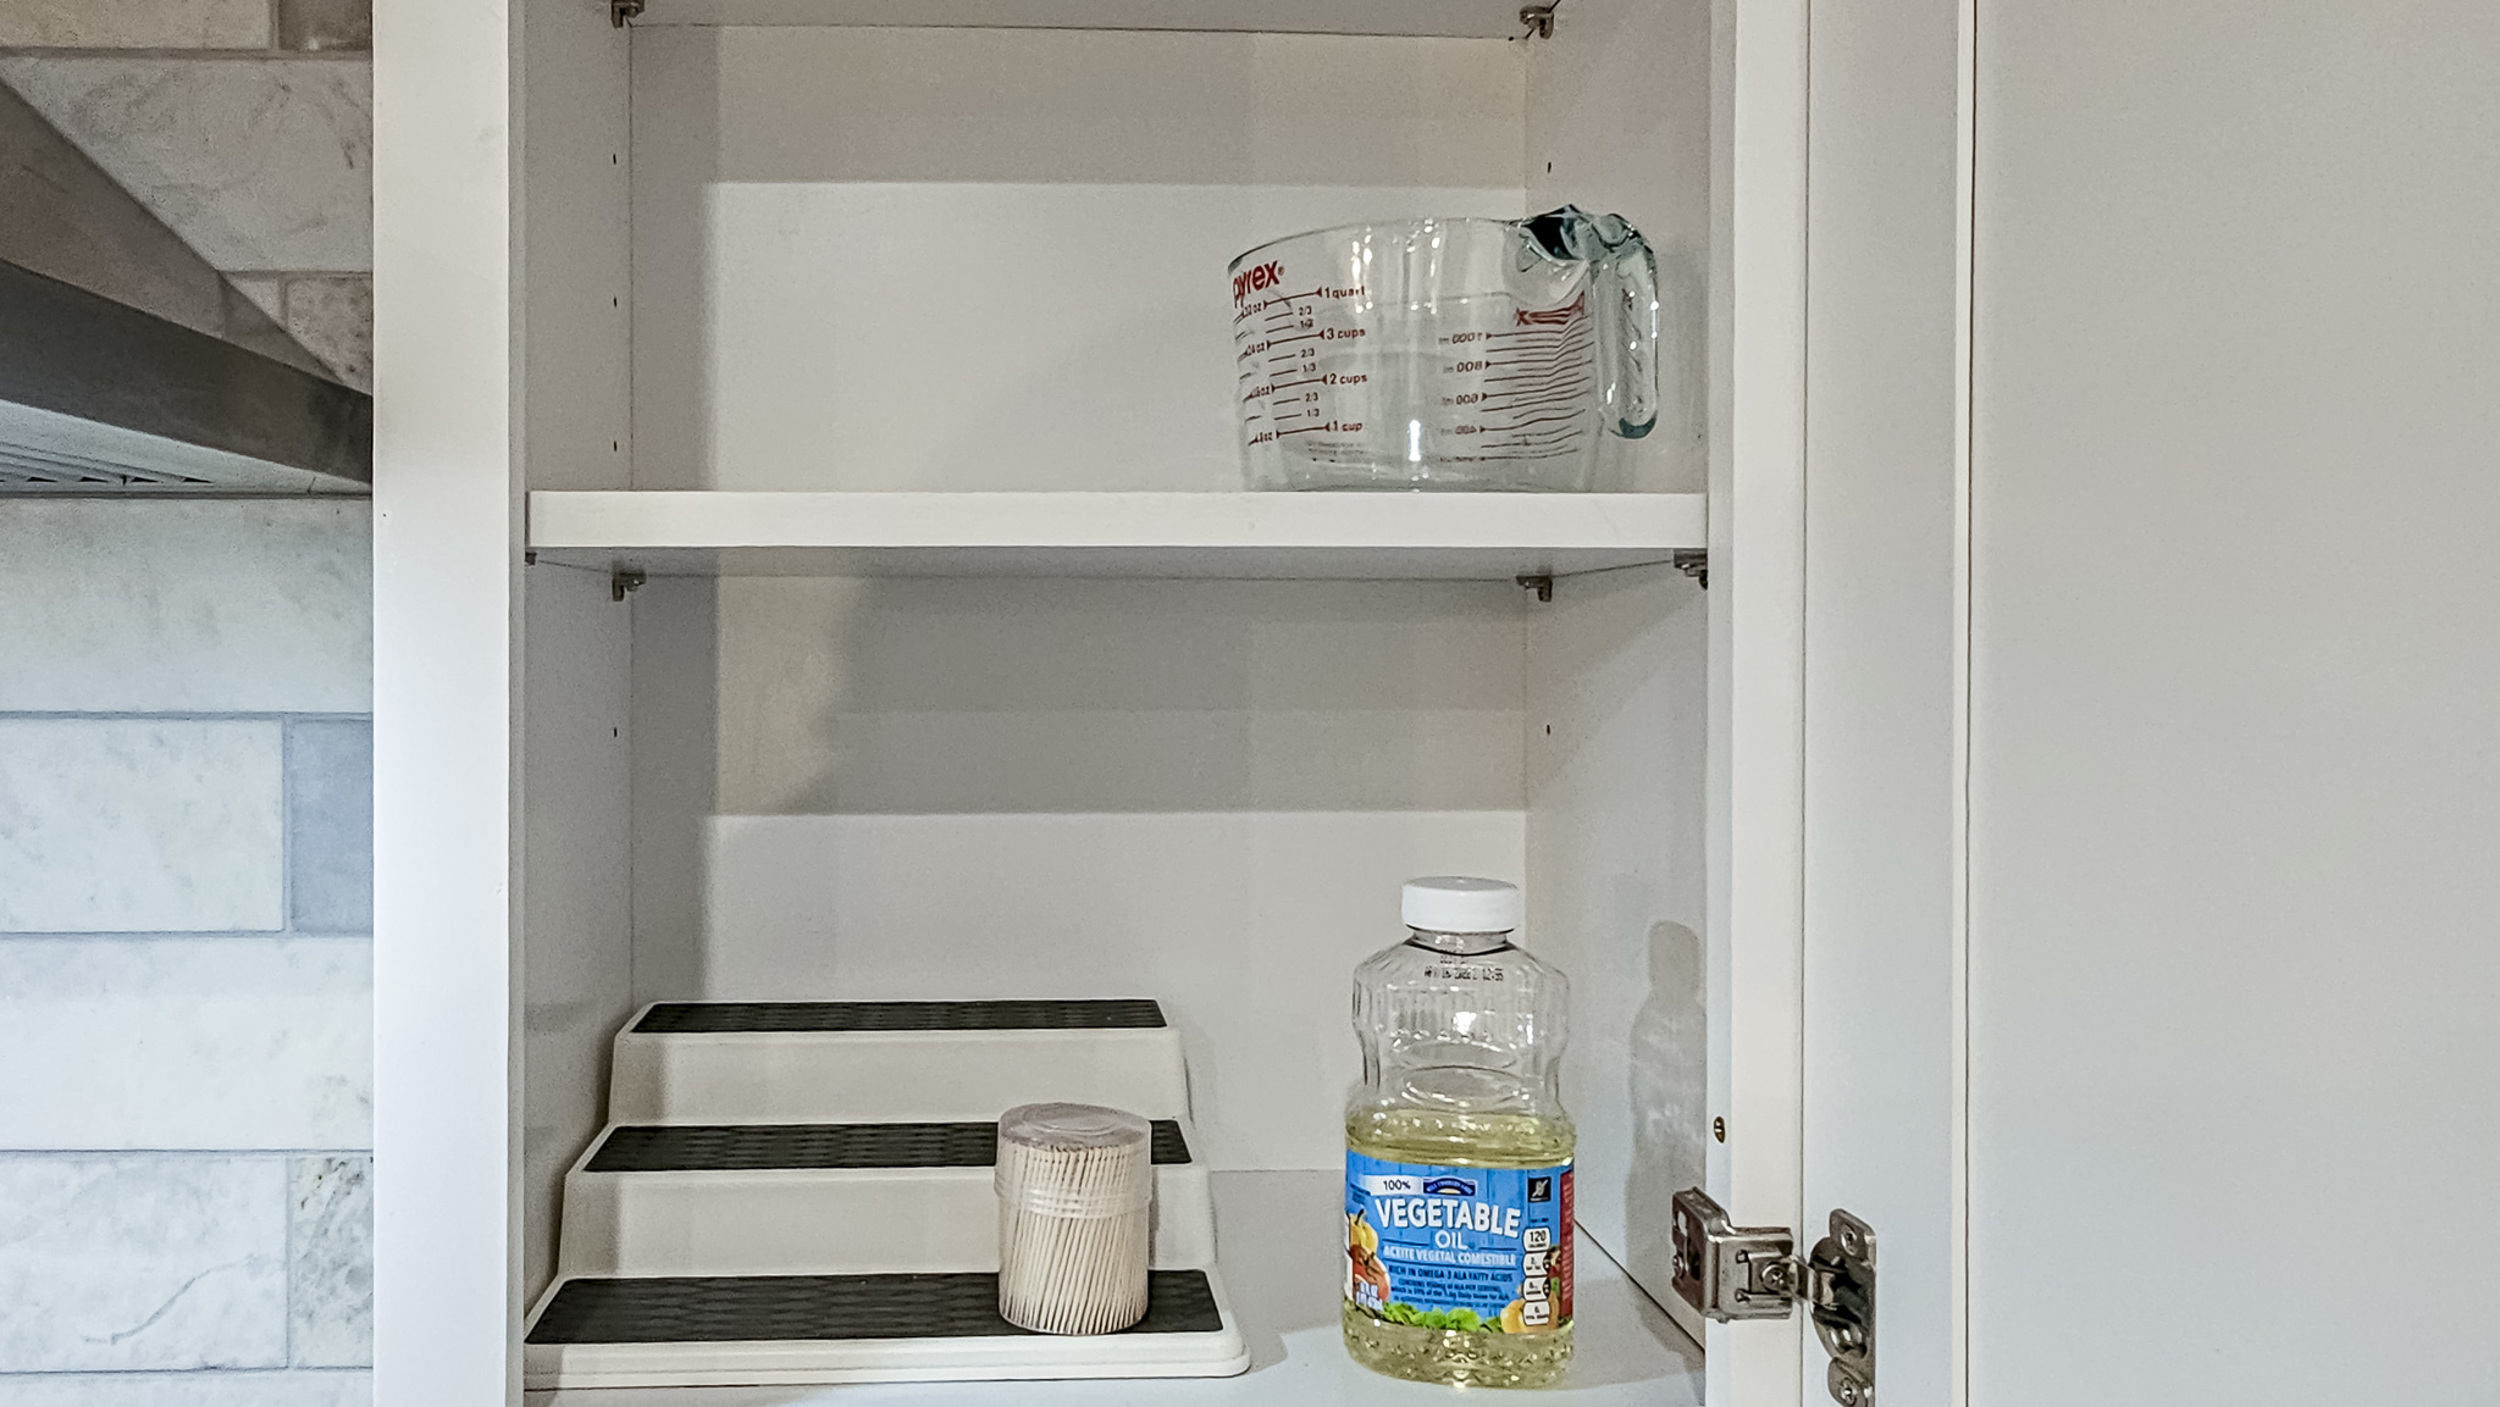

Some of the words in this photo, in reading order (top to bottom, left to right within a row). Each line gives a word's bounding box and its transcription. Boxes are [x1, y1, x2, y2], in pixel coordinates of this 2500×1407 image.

[1324, 286, 1331, 299] 1
[1326, 330, 1335, 340] 3
[1337, 328, 1366, 340] cups
[1329, 372, 1338, 385] 2
[1339, 374, 1368, 386] cups
[1333, 420, 1338, 432] 1
[1341, 421, 1363, 433] cup
[1383, 1178, 1412, 1191] 100%
[1374, 1197, 1521, 1239] VEGETABLE
[1434, 1229, 1469, 1251] OIL
[1529, 1229, 1547, 1243] 120
[1382, 1245, 1415, 1260] ACEITE
[1416, 1248, 1457, 1264] VEGETAL
[1457, 1252, 1518, 1267] COMESTIBLE
